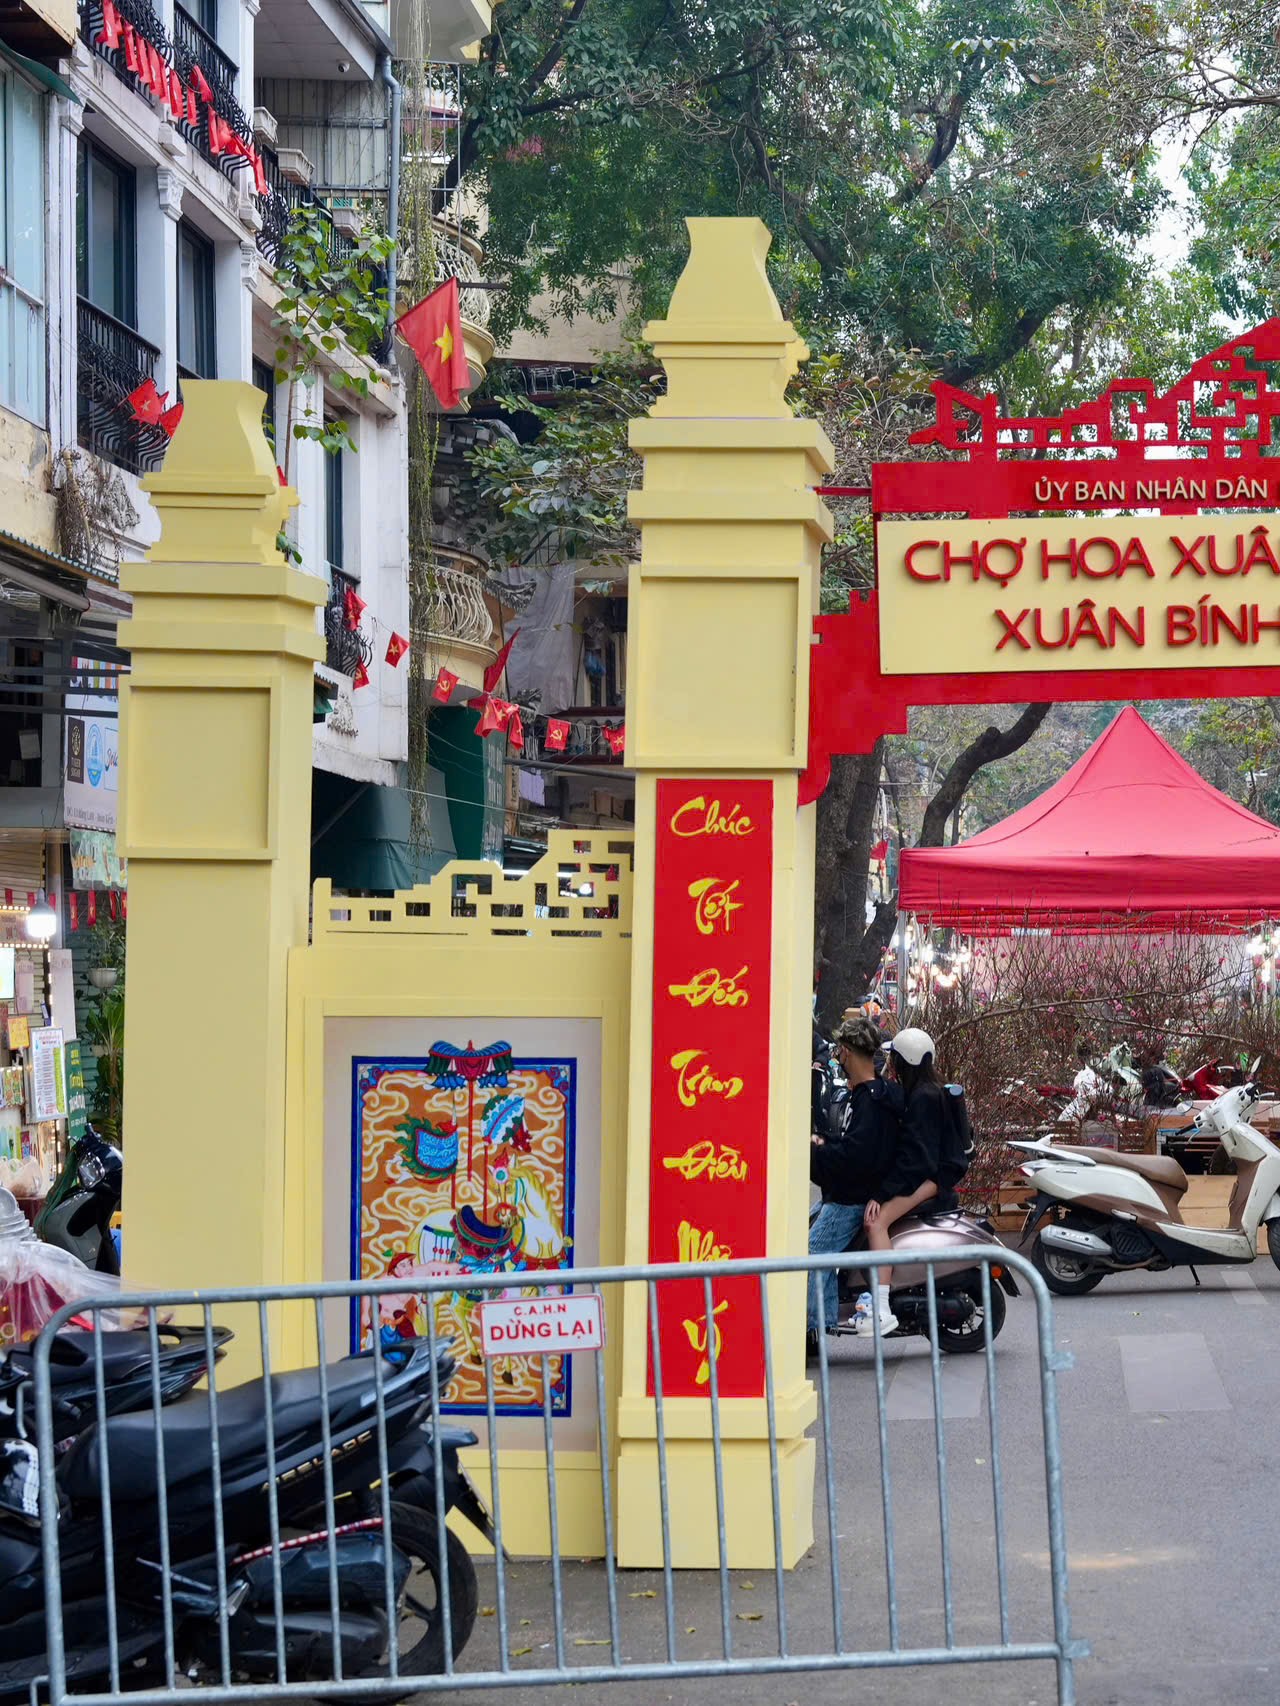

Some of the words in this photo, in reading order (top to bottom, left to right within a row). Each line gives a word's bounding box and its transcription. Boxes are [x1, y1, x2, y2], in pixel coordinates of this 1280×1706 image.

[1034, 477, 1068, 502] ỦY
[1075, 480, 1125, 501] BAN
[1136, 476, 1206, 500] NHÂN
[1215, 475, 1268, 499] DÂN
[904, 536, 1027, 588] CHỢ
[1040, 536, 1155, 580] HOA
[995, 598, 1145, 651] XUÂN
[670, 795, 755, 837] Chúc
[687, 876, 745, 935] Tết
[668, 965, 749, 1008] Đến
[662, 1140, 748, 1181] Điều
[490, 1318, 552, 1341] DỪNG
[557, 1319, 594, 1340] LẠI
[514, 1304, 567, 1316] C.A.H.N
